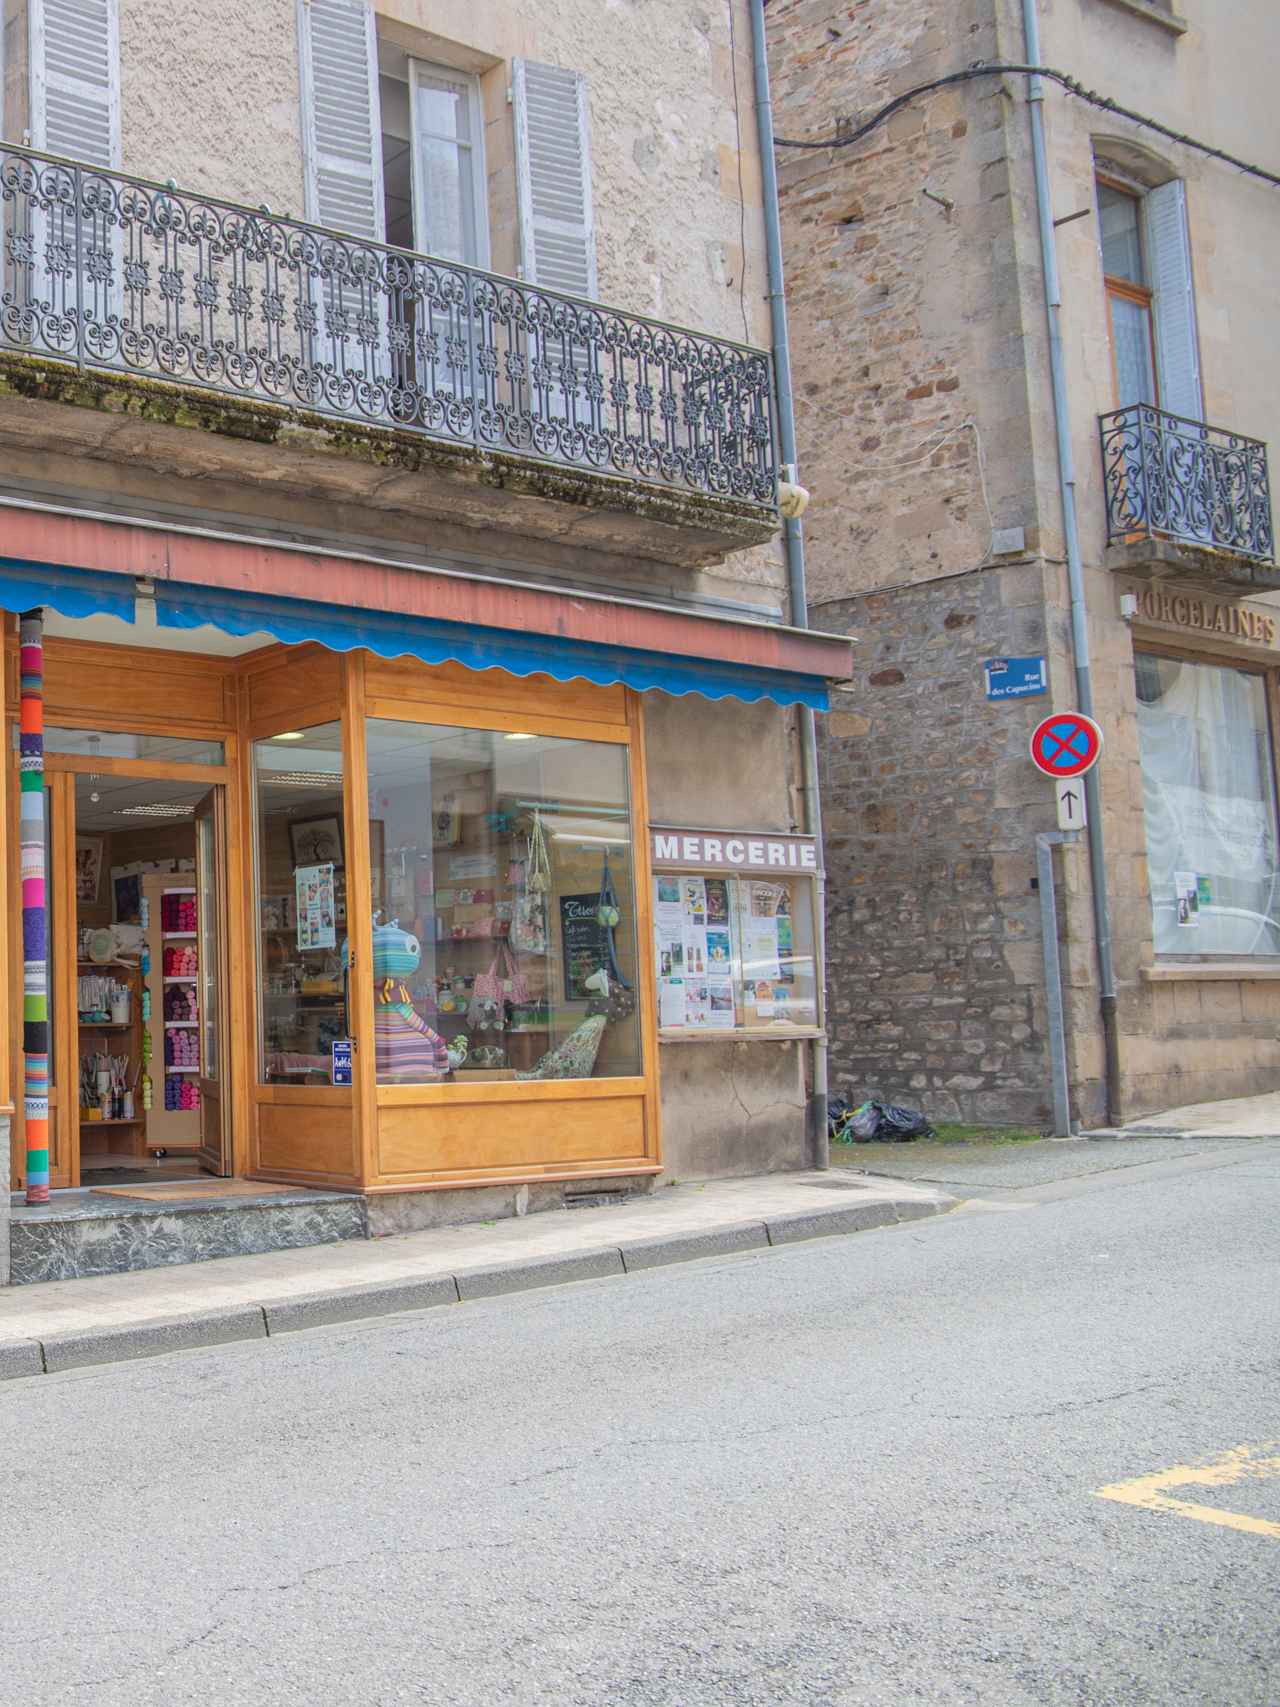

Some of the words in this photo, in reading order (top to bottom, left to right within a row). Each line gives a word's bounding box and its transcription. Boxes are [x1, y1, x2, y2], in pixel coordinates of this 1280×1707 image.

[1128, 588, 1275, 641] PORCELAINES
[1024, 673, 1040, 681] Rue
[991, 687, 1005, 696] des
[1006, 682, 1041, 694] Capucins
[655, 835, 817, 867] MERCERIE
